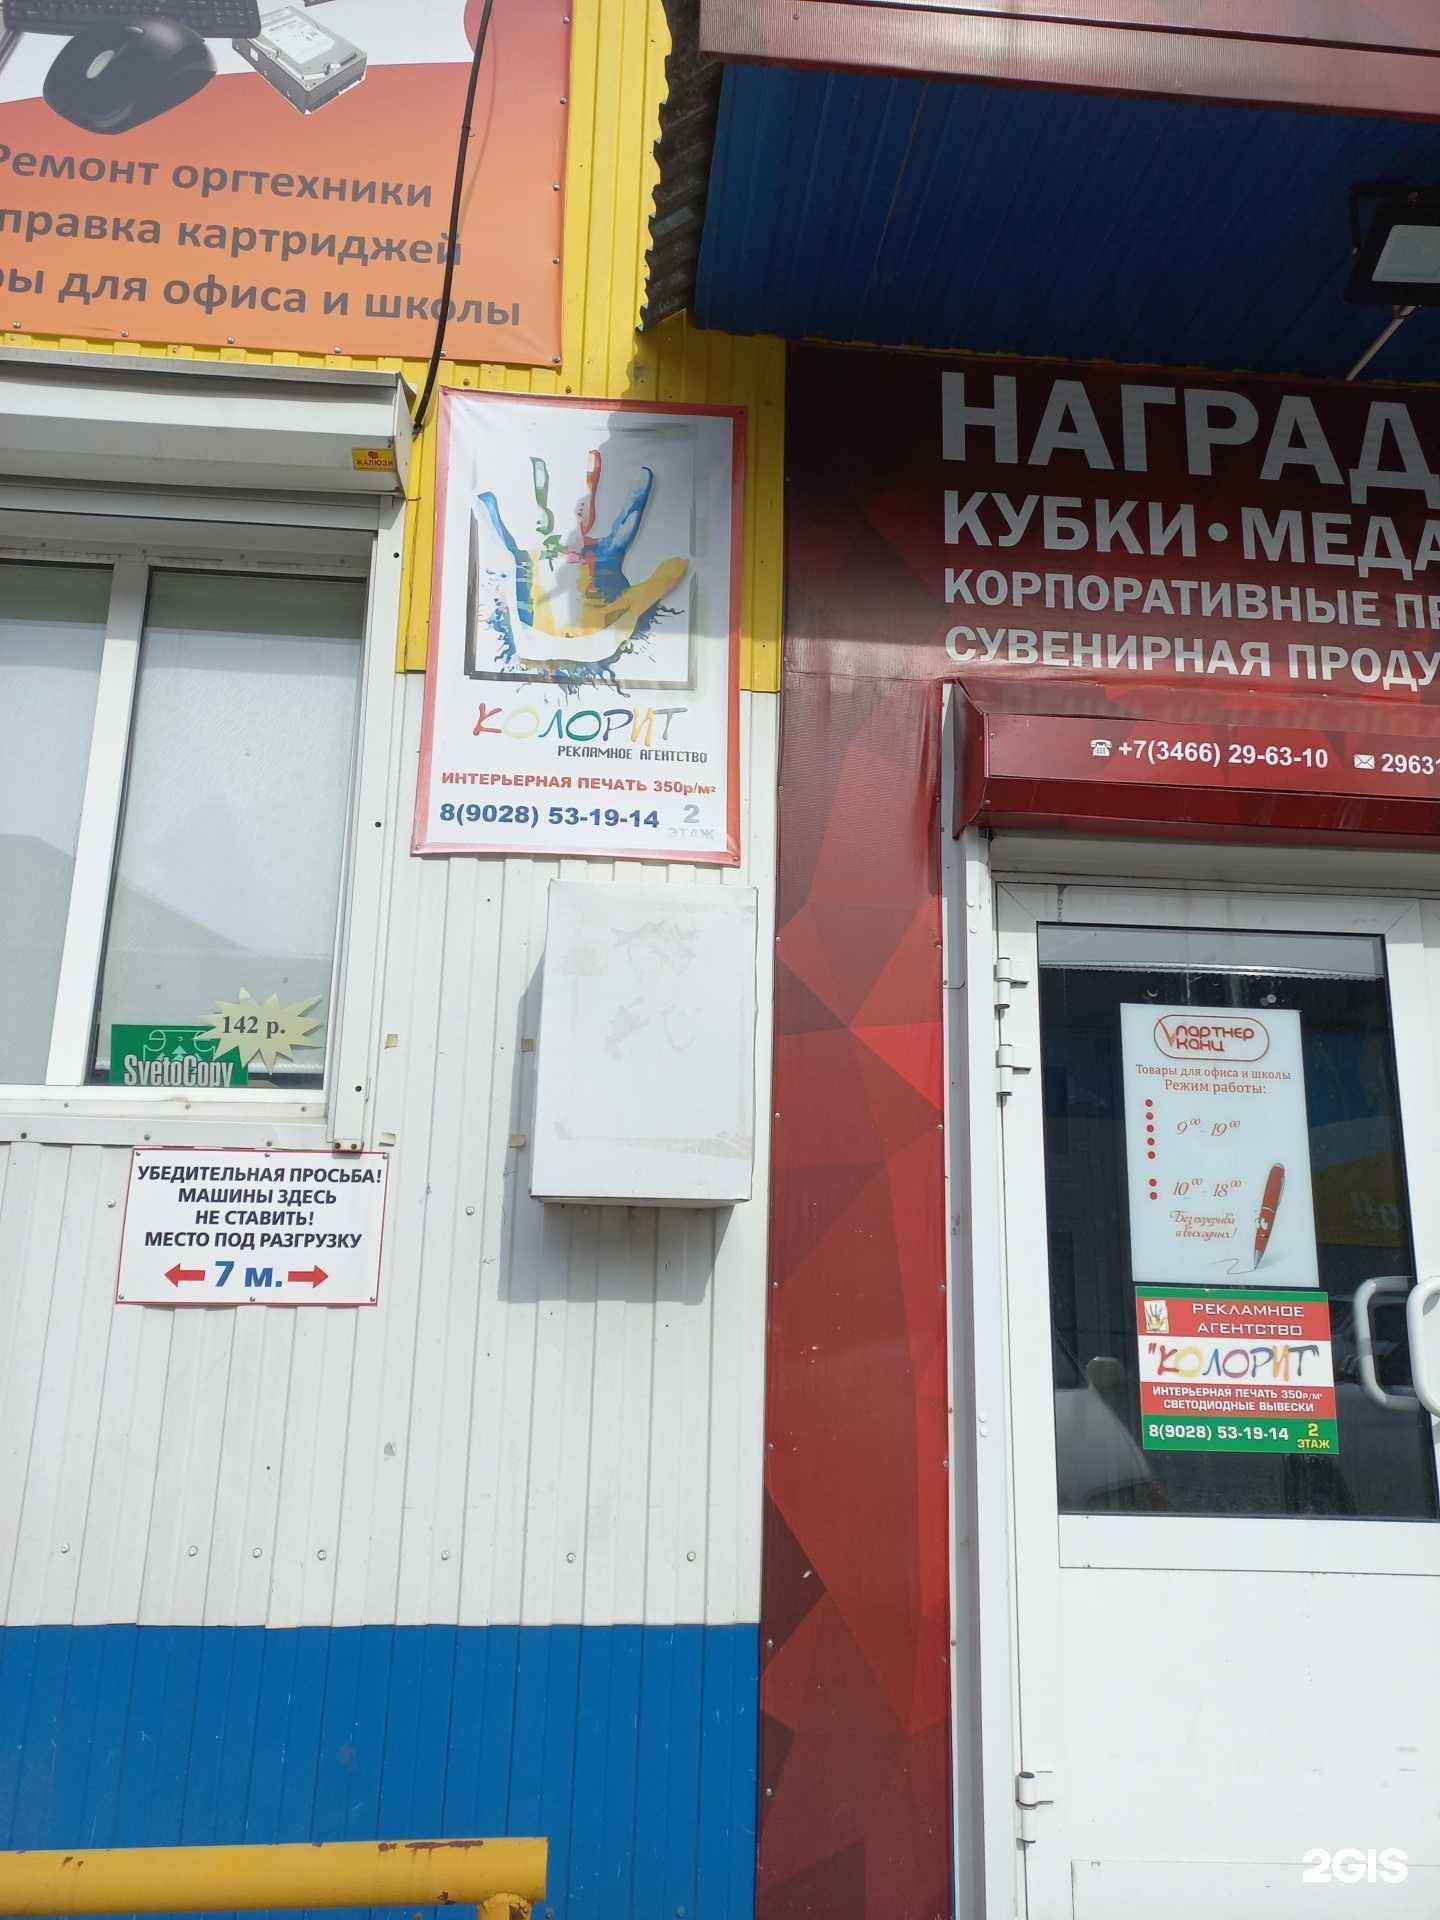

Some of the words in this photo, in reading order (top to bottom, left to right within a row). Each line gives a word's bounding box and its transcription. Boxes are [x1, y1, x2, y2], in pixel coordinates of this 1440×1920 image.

[172, 164, 432, 207] оргтехники
[178, 223, 461, 266] картриджей
[0, 268, 44, 294] ы
[58, 272, 147, 305] для
[163, 275, 306, 314] офиса
[324, 291, 348, 316] и
[366, 293, 520, 326] школы
[942, 372, 1440, 510] НАГРАД
[944, 490, 1197, 558] КУБКИ
[945, 568, 1381, 628] КОРПОРАТИВНЫЕ
[945, 626, 1271, 677] СУВЕНИРНАЯ
[1288, 644, 1440, 692] ПРОДУ
[473, 703, 688, 747] КОЛОРИТ
[557, 745, 633, 759] РЕКЛАМНОЕ
[640, 749, 708, 763] АГЕНТСТВО
[1118, 739, 1221, 767] +7(3466)
[1228, 744, 1329, 768] 29-63-10
[441, 772, 572, 789] ИНТЕРЬЕРНАЯ
[577, 777, 648, 792] ПЕЧАТЬ
[440, 803, 539, 828] 8(9028)
[548, 807, 659, 828] 53-19-14
[684, 804, 700, 824] 2
[223, 1016, 258, 1033] 142
[266, 1021, 286, 1038] р.
[124, 1055, 234, 1087] SvetoCopy
[1136, 1064, 1178, 1077] Товары
[1180, 1067, 1200, 1077] для
[1204, 1067, 1239, 1079] офиса
[1251, 1071, 1291, 1080] школы
[1165, 1080, 1208, 1092] Режим
[1213, 1081, 1267, 1095] работы:
[137, 1166, 285, 1183] УБЕДИТЕЛЬНАЯ
[290, 1168, 382, 1183] ПРОСЬБА!
[178, 1188, 275, 1204] МАШИНЫ
[278, 1190, 337, 1207] ЗДЕСЬ
[195, 1210, 220, 1225] НЕ
[224, 1210, 314, 1226] СТАВИТЬ!
[144, 1232, 210, 1248] МЕСТО
[214, 1232, 255, 1250] ПОД
[259, 1233, 362, 1249] РАЗГРУЗКУ
[213, 1261, 235, 1288] 7
[1192, 1303, 1305, 1317] РЕКЛАМНОЕ
[1197, 1322, 1303, 1336] АГЕНТСТВО
[1152, 1386, 1232, 1397] ИНТЕРЬЕРНАЯ
[1235, 1388, 1278, 1399] ПЕЧАТЬ
[1163, 1400, 1255, 1412] СВЕТОДИОДНЫЕ
[1259, 1402, 1314, 1412] ВЫВЕСКИ
[1149, 1424, 1212, 1441] 8(9028)
[1218, 1426, 1289, 1440] 53-19-14
[1308, 1423, 1319, 1437] 2
[1297, 1439, 1330, 1449] ЭТАЖ
